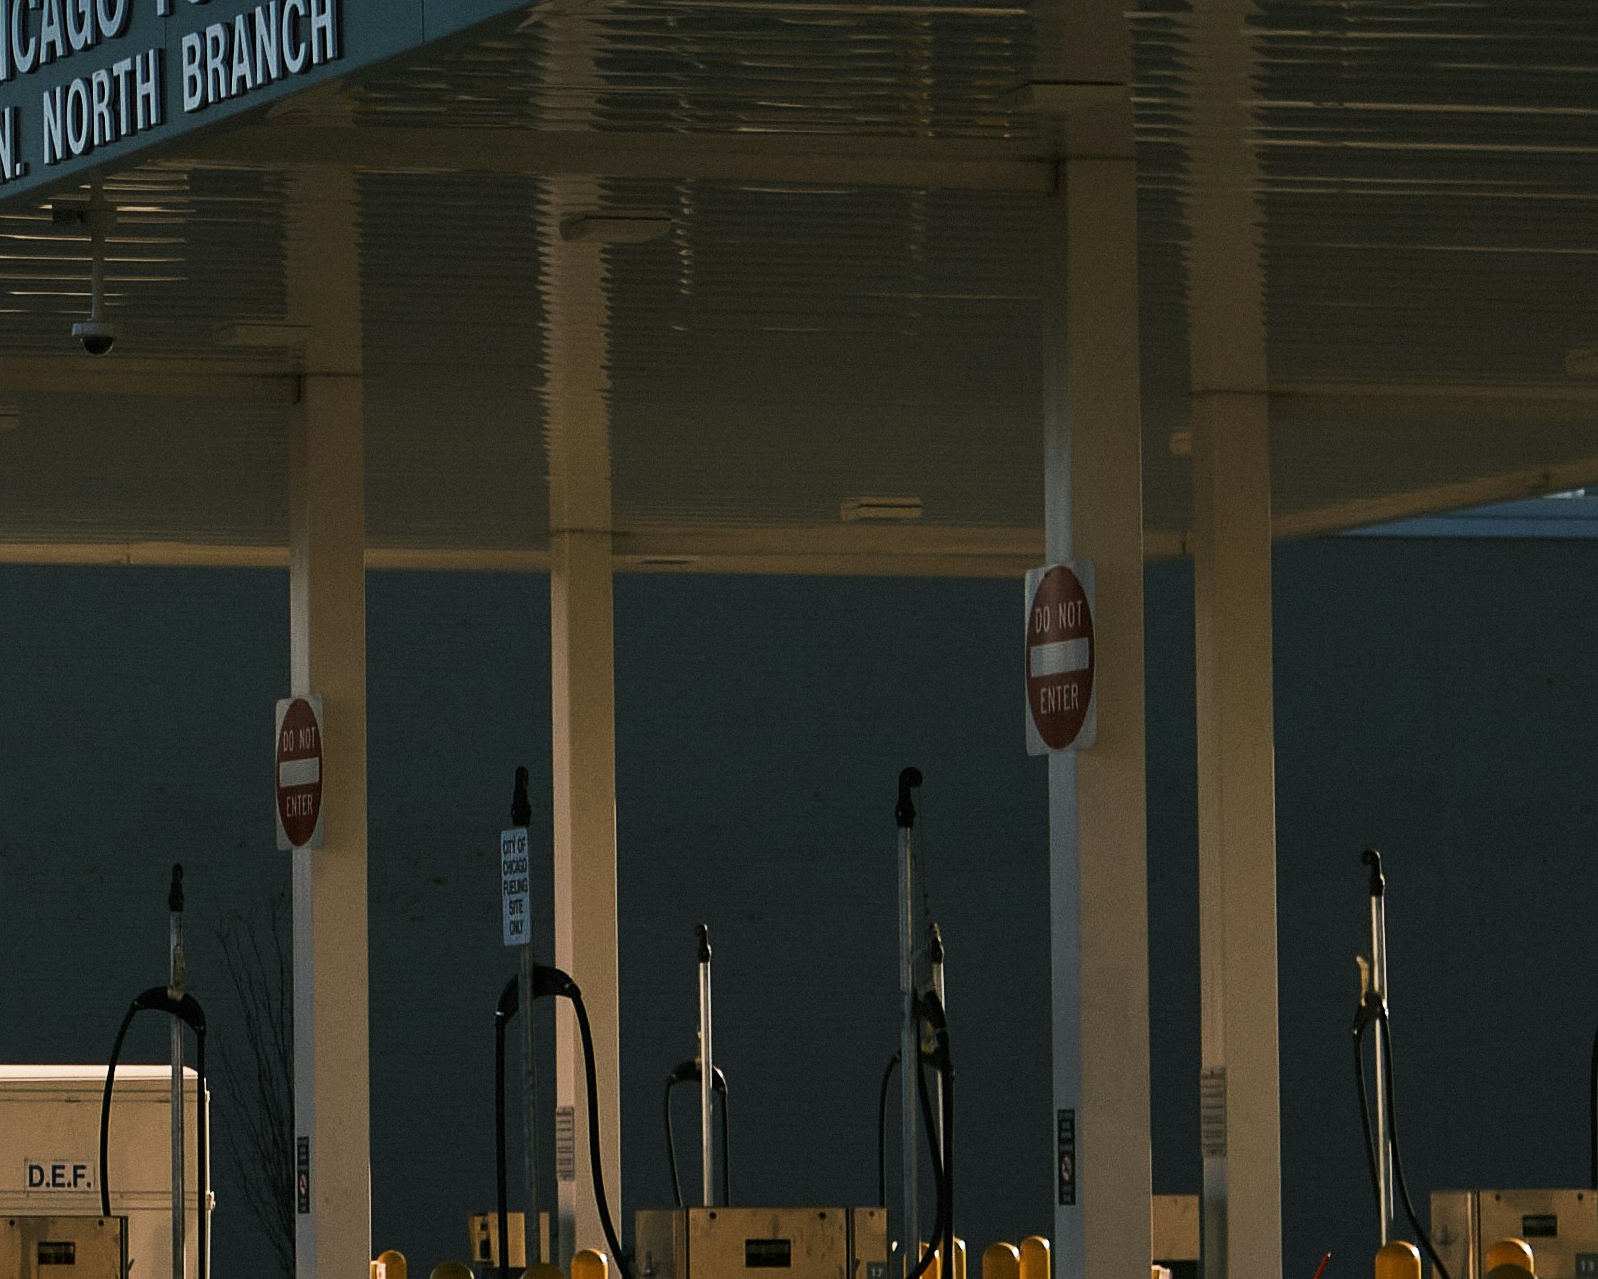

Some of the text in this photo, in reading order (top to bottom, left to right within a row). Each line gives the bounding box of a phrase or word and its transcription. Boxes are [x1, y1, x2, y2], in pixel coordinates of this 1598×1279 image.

[42, 47, 165, 166] NORTH
[1035, 599, 1083, 634] DO NOT
[1040, 682, 1079, 715] ENTER
[283, 726, 317, 752] DO NOT
[286, 793, 313, 818] ENTER
[503, 836, 526, 855] CITY OF
[503, 857, 527, 876] CHICAGO
[509, 898, 524, 915] SITE
[28, 1164, 92, 1188] D.E.F.
